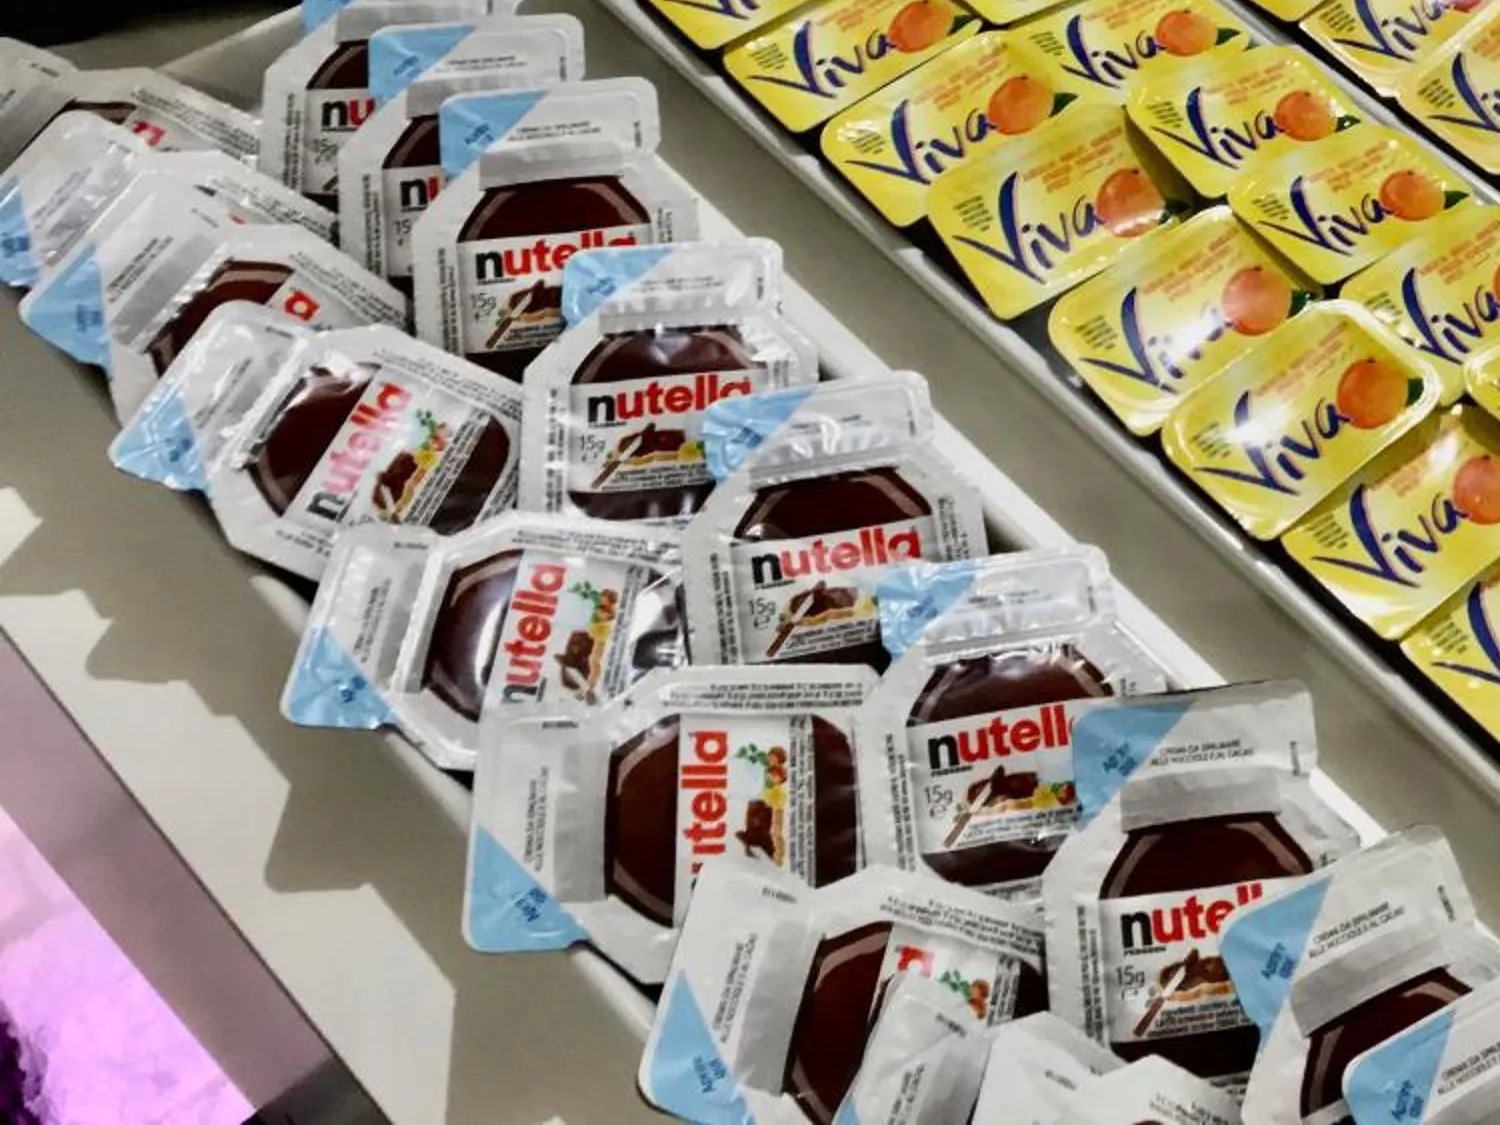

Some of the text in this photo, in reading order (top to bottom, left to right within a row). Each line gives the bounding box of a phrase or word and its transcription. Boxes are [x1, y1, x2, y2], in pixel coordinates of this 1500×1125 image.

[748, 21, 896, 97] Viva
[1061, 15, 1167, 88] Viva
[846, 99, 998, 185] Viva
[1151, 87, 1283, 169] Viva
[953, 172, 1103, 283] Viva
[1257, 176, 1391, 256] Viva
[306, 382, 412, 523] nutella
[1194, 391, 1350, 495] Viva
[752, 527, 922, 584] nutella
[1312, 484, 1470, 588] Viva
[503, 561, 569, 706] nutella
[928, 704, 1073, 770] nutell
[681, 731, 728, 891] tella
